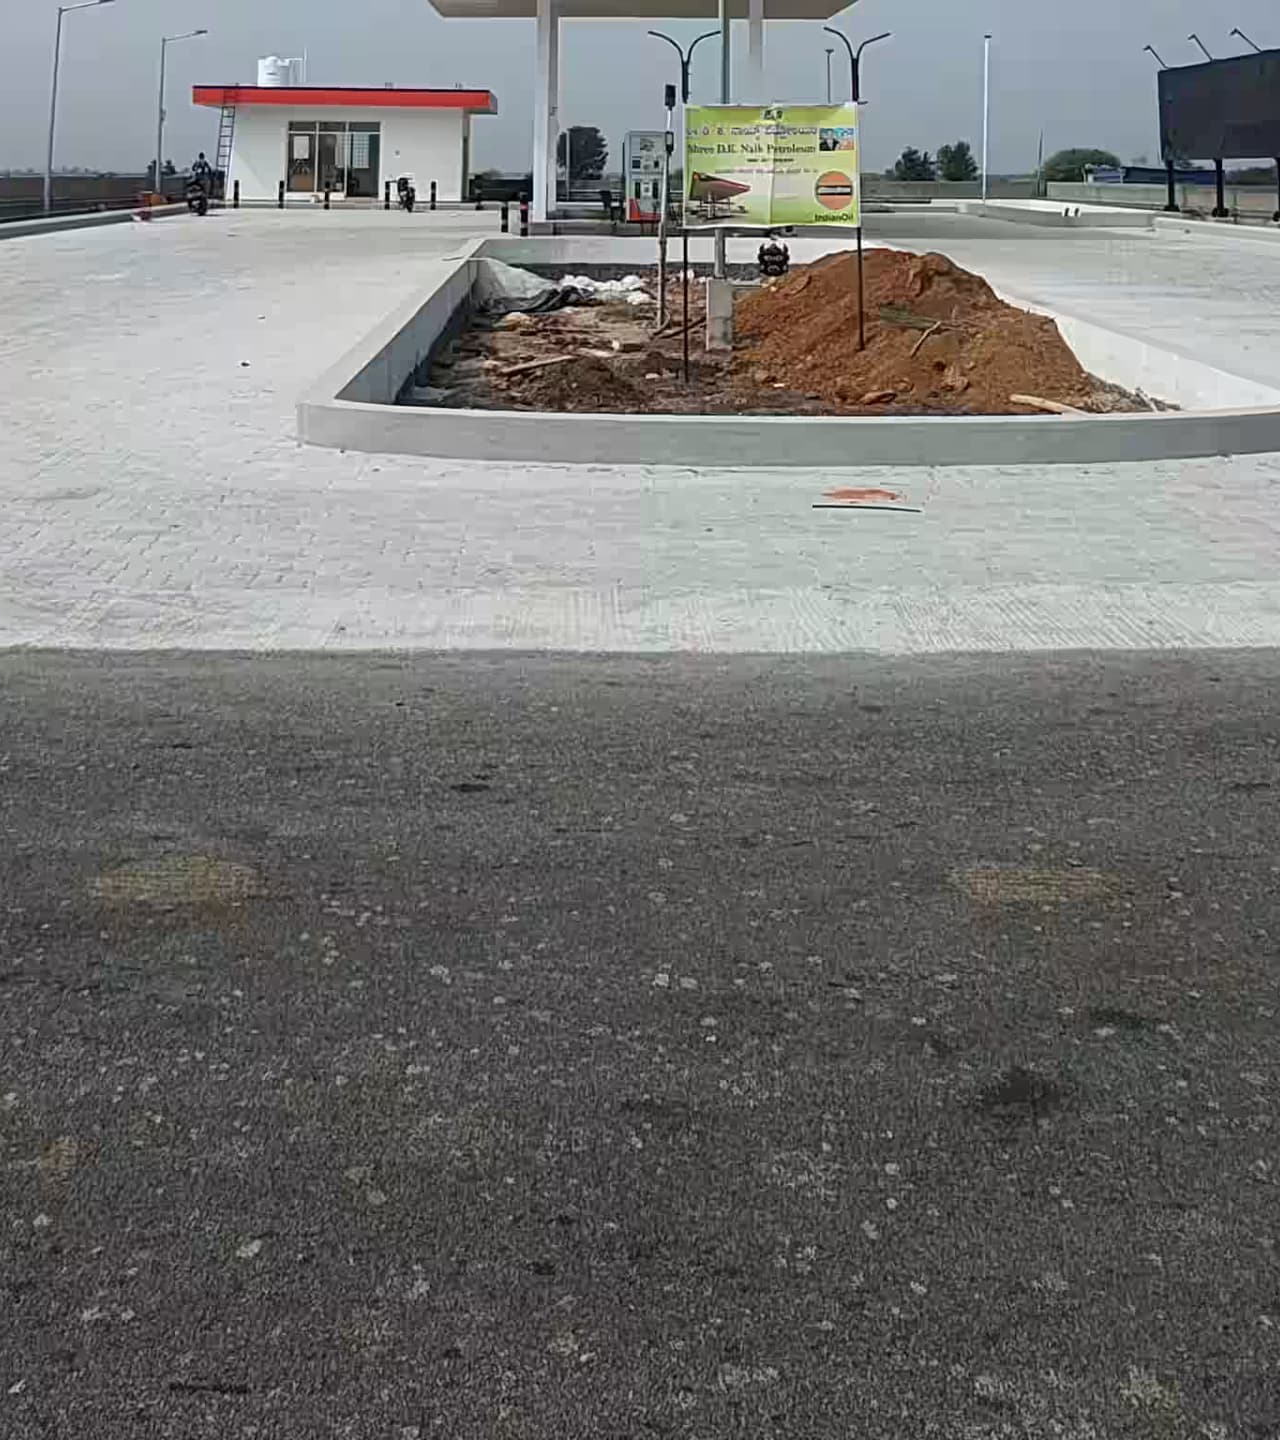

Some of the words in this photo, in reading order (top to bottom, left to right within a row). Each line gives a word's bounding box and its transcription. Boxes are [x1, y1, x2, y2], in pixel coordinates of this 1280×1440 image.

[740, 143, 764, 153] Naik
[767, 143, 817, 154] Petroleum
[814, 212, 854, 222] IndianOil
